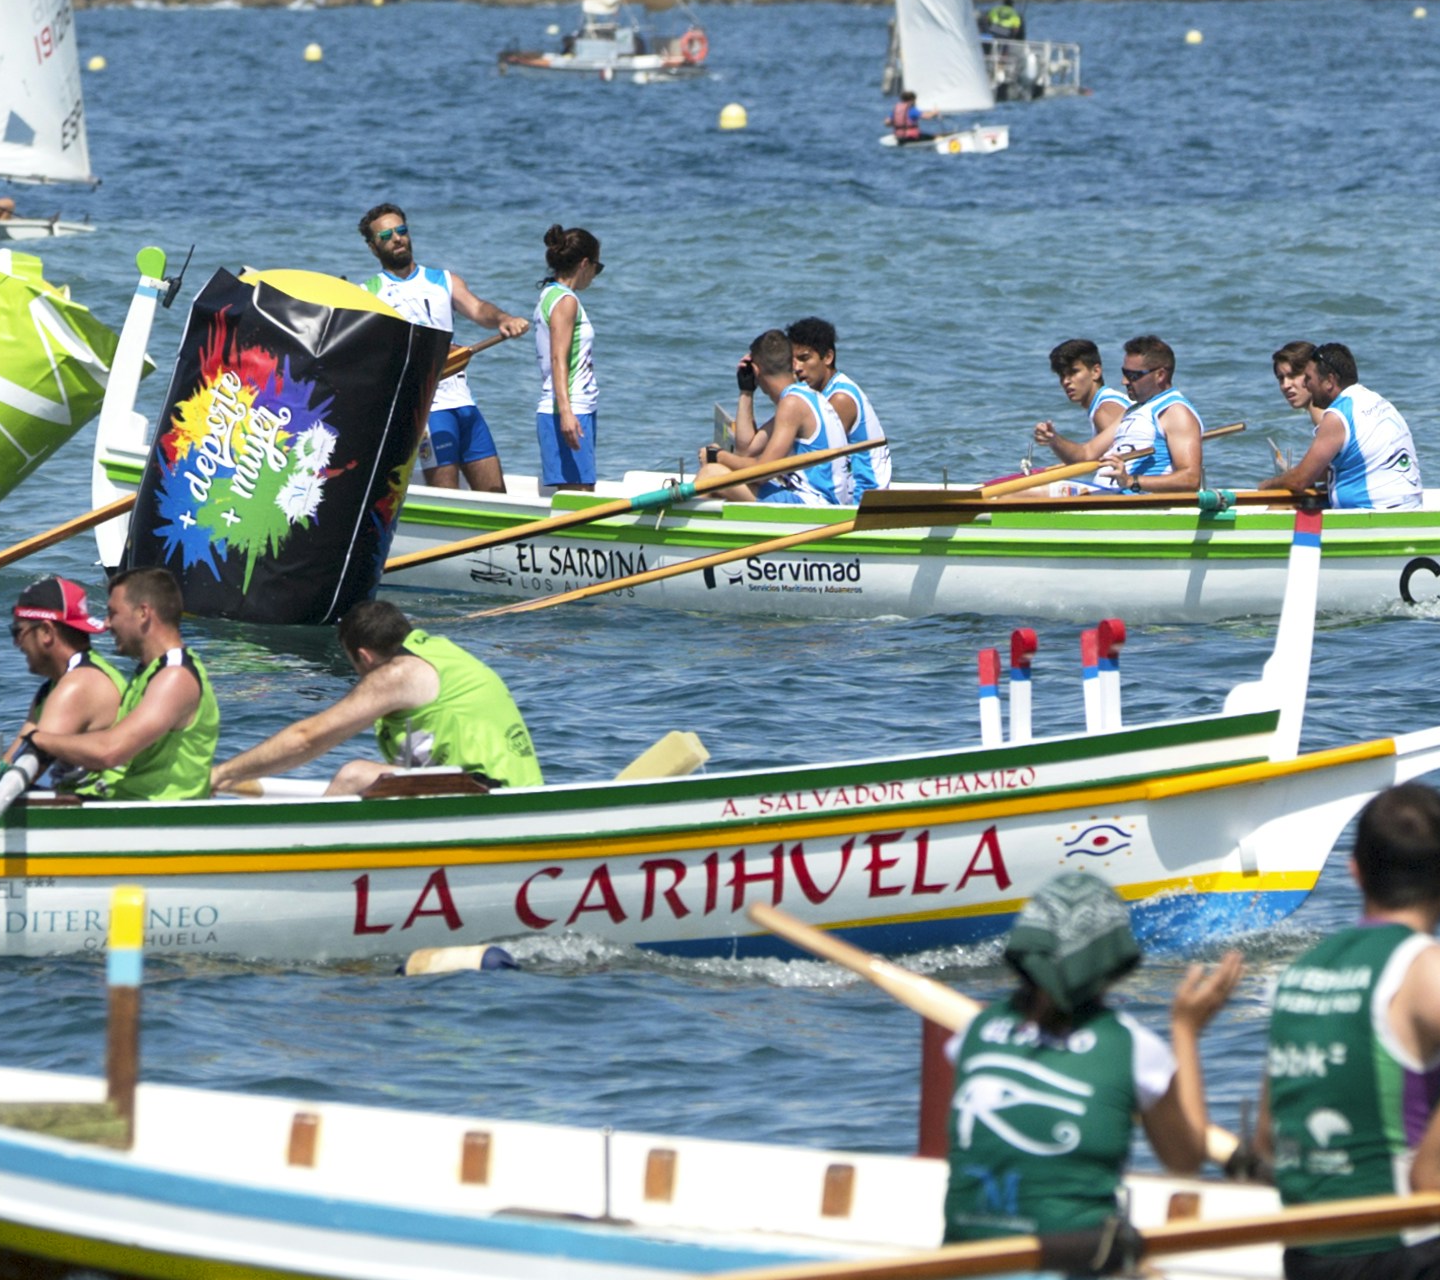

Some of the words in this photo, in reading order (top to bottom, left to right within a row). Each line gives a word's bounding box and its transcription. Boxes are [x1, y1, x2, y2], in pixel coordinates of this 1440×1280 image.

[185, 370, 245, 502] deporte
[228, 405, 291, 500] mujer
[516, 542, 543, 574] EL
[521, 577, 554, 592] LOS
[746, 555, 861, 583] Servimad
[721, 796, 745, 818] A.
[759, 781, 906, 814] SALVADOR
[918, 765, 1037, 801] CHAMIZO
[352, 867, 464, 937] LA
[515, 824, 1014, 930] CARIHUELA
